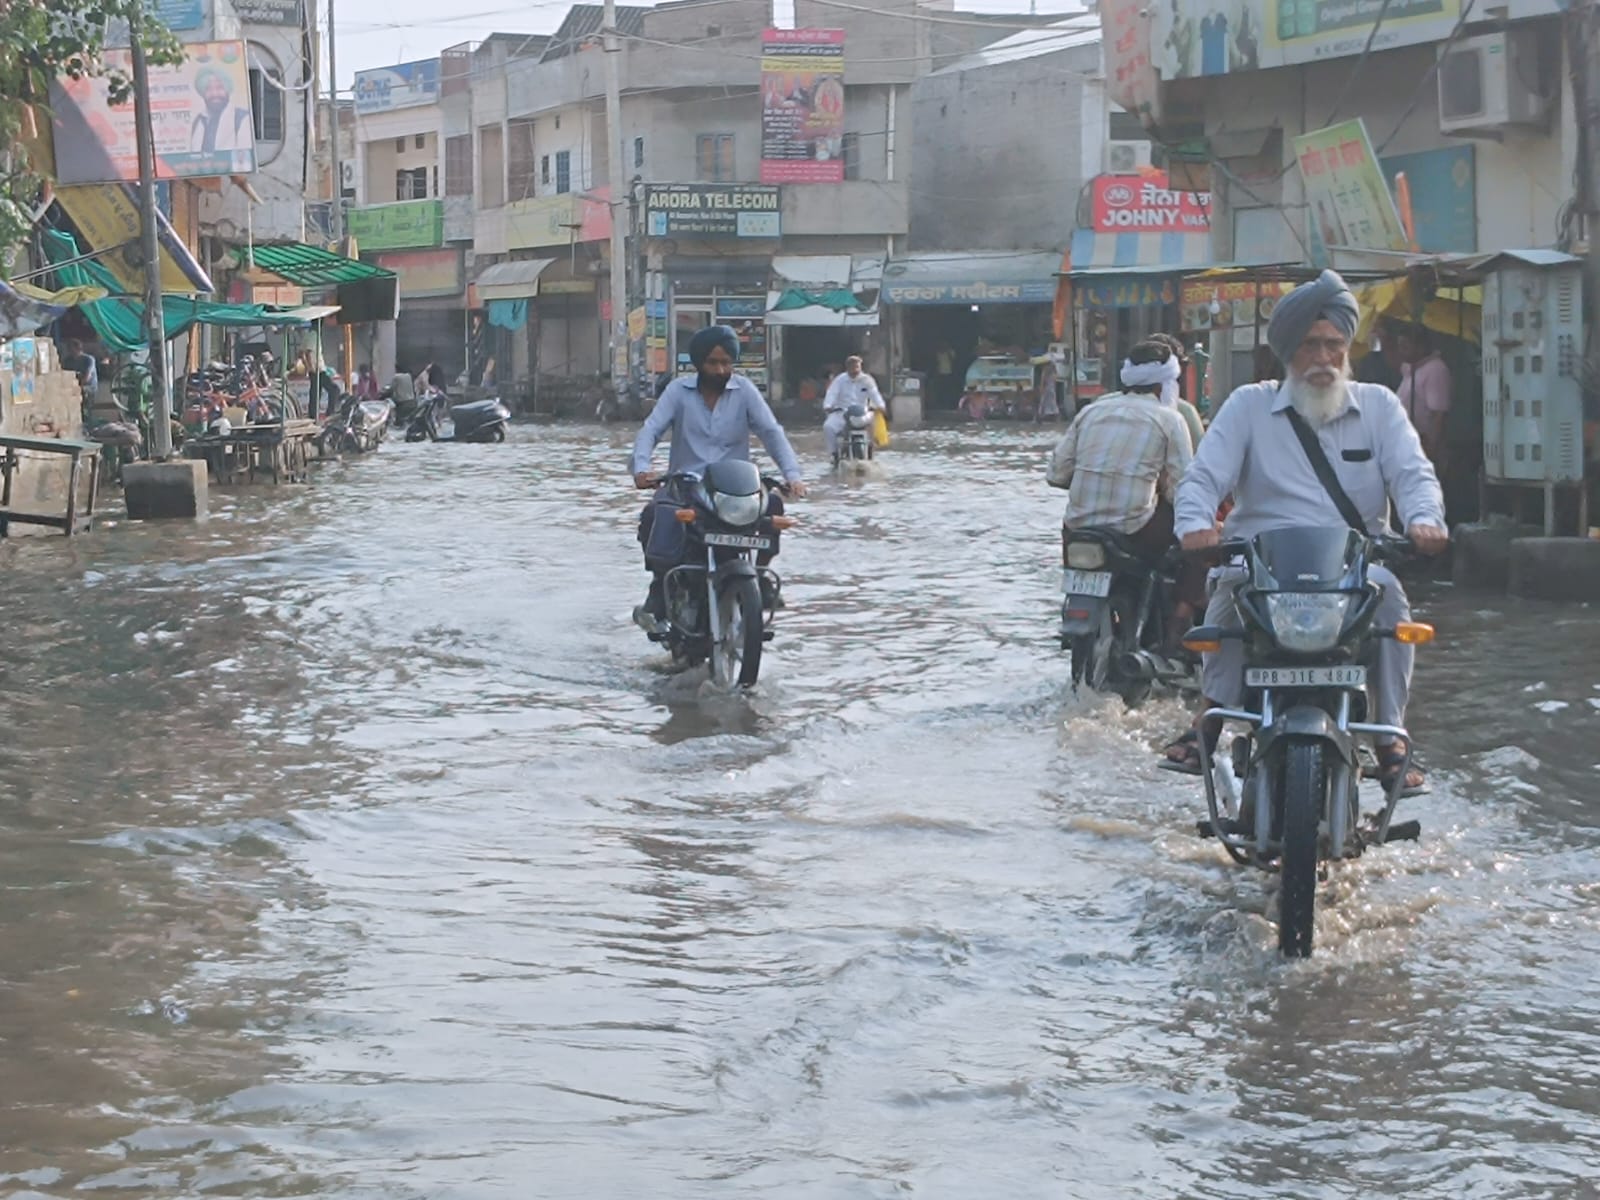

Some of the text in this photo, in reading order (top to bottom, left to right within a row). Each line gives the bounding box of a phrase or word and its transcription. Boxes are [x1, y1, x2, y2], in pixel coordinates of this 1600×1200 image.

[648, 192, 777, 209] ARORA TELECOM
[1102, 208, 1180, 227] JOHNY
